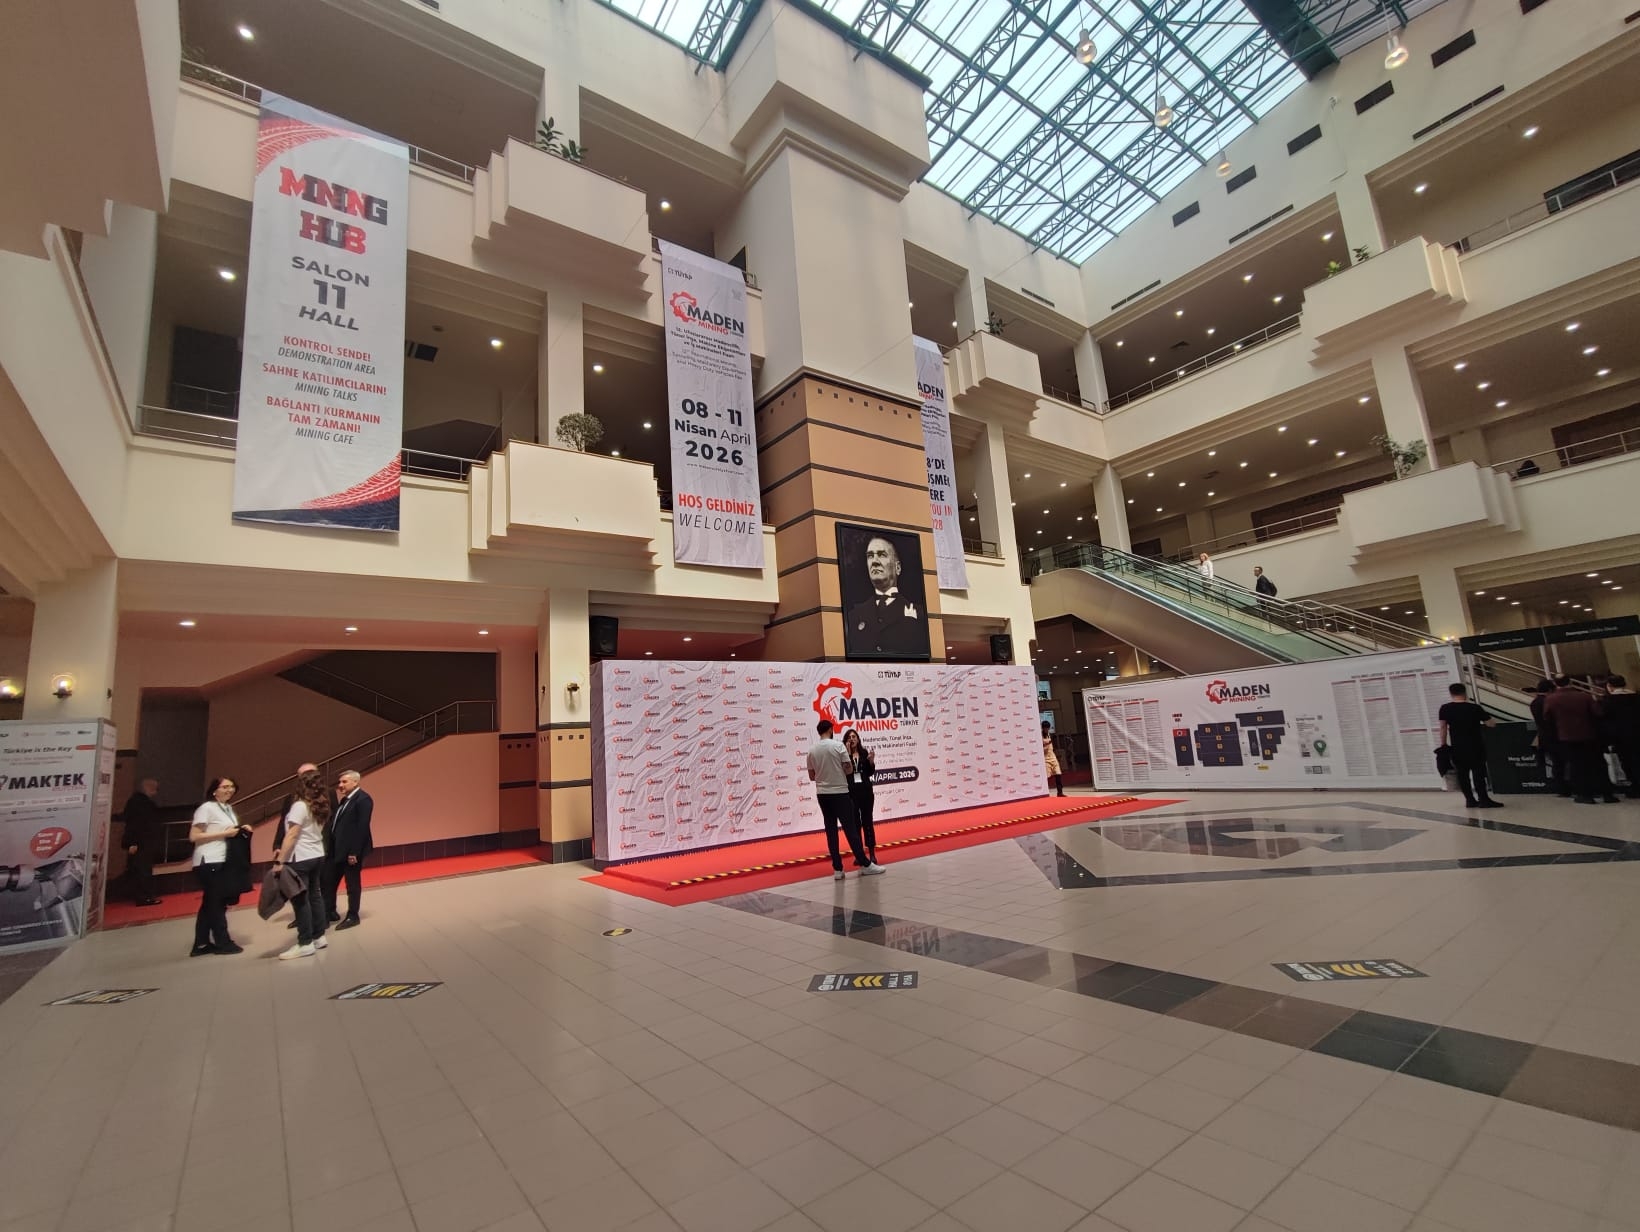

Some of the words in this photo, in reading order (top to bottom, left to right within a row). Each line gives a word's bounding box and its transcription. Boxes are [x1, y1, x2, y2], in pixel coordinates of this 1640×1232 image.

[299, 210, 367, 255] HUB
[291, 256, 370, 287] SALON
[313, 279, 346, 310] 11
[298, 306, 359, 331] HALL
[687, 305, 745, 334] MADEN
[697, 321, 729, 336] MINING
[283, 336, 333, 354] KONTROL
[337, 347, 371, 362] SENDE!
[278, 347, 352, 370] DEMONSTRATION
[354, 363, 376, 375] AREA
[262, 363, 299, 378] SAHNE
[302, 370, 387, 396] KATILIMCILARIN!
[917, 381, 944, 400] ADEN
[295, 382, 330, 397] MINING
[332, 390, 358, 402] TALKS
[266, 396, 320, 414] BAĞLANTI
[324, 406, 381, 424] KURMANIN
[681, 398, 709, 419] 08
[727, 408, 743, 427] 11
[288, 412, 311, 425] TAM
[315, 417, 361, 433] ZAMANI!
[674, 419, 717, 439] Nisan
[720, 429, 751, 446] April
[295, 427, 330, 441] MINING
[333, 433, 354, 445] CAFE
[685, 440, 744, 466] 2026
[926, 456, 946, 471] 8'DE
[678, 493, 703, 512] HOŞ
[706, 497, 756, 517] GELDİNİZ
[929, 488, 945, 502] ERE
[930, 503, 942, 516] OU
[679, 512, 757, 535] WELCOME
[1219, 683, 1271, 699] MADEN
[1229, 695, 1257, 704] MINING
[838, 696, 919, 721] MADEN
[855, 719, 899, 733] MINING
[8, 773, 85, 790] MAKTEK
[869, 771, 899, 783] N/APRIL
[898, 770, 916, 779] 2026
